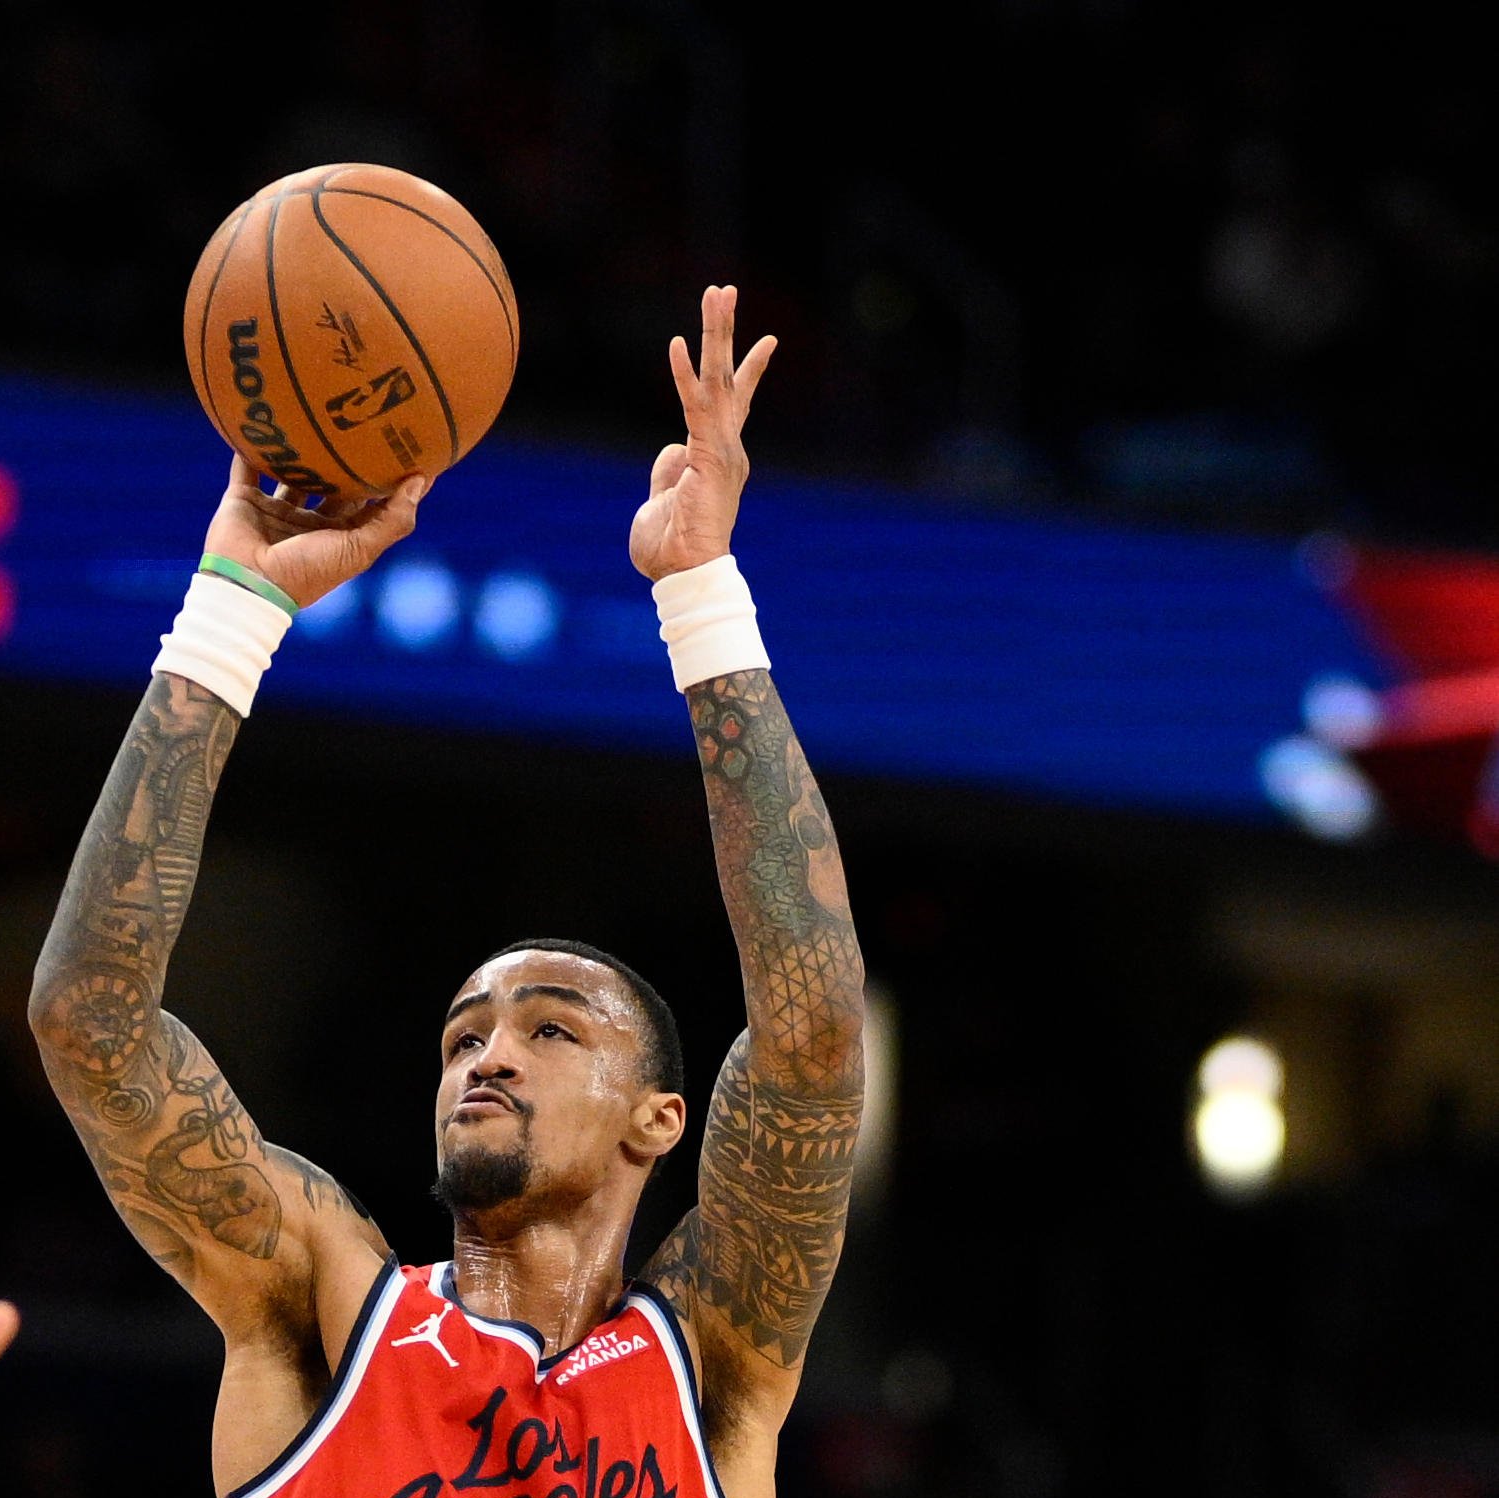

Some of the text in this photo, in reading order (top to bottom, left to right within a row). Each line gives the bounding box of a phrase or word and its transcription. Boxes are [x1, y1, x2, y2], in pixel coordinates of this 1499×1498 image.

[555, 1335, 649, 1386] RWANDA
[567, 1331, 618, 1362] VISIT
[450, 1386, 581, 1491] Los
